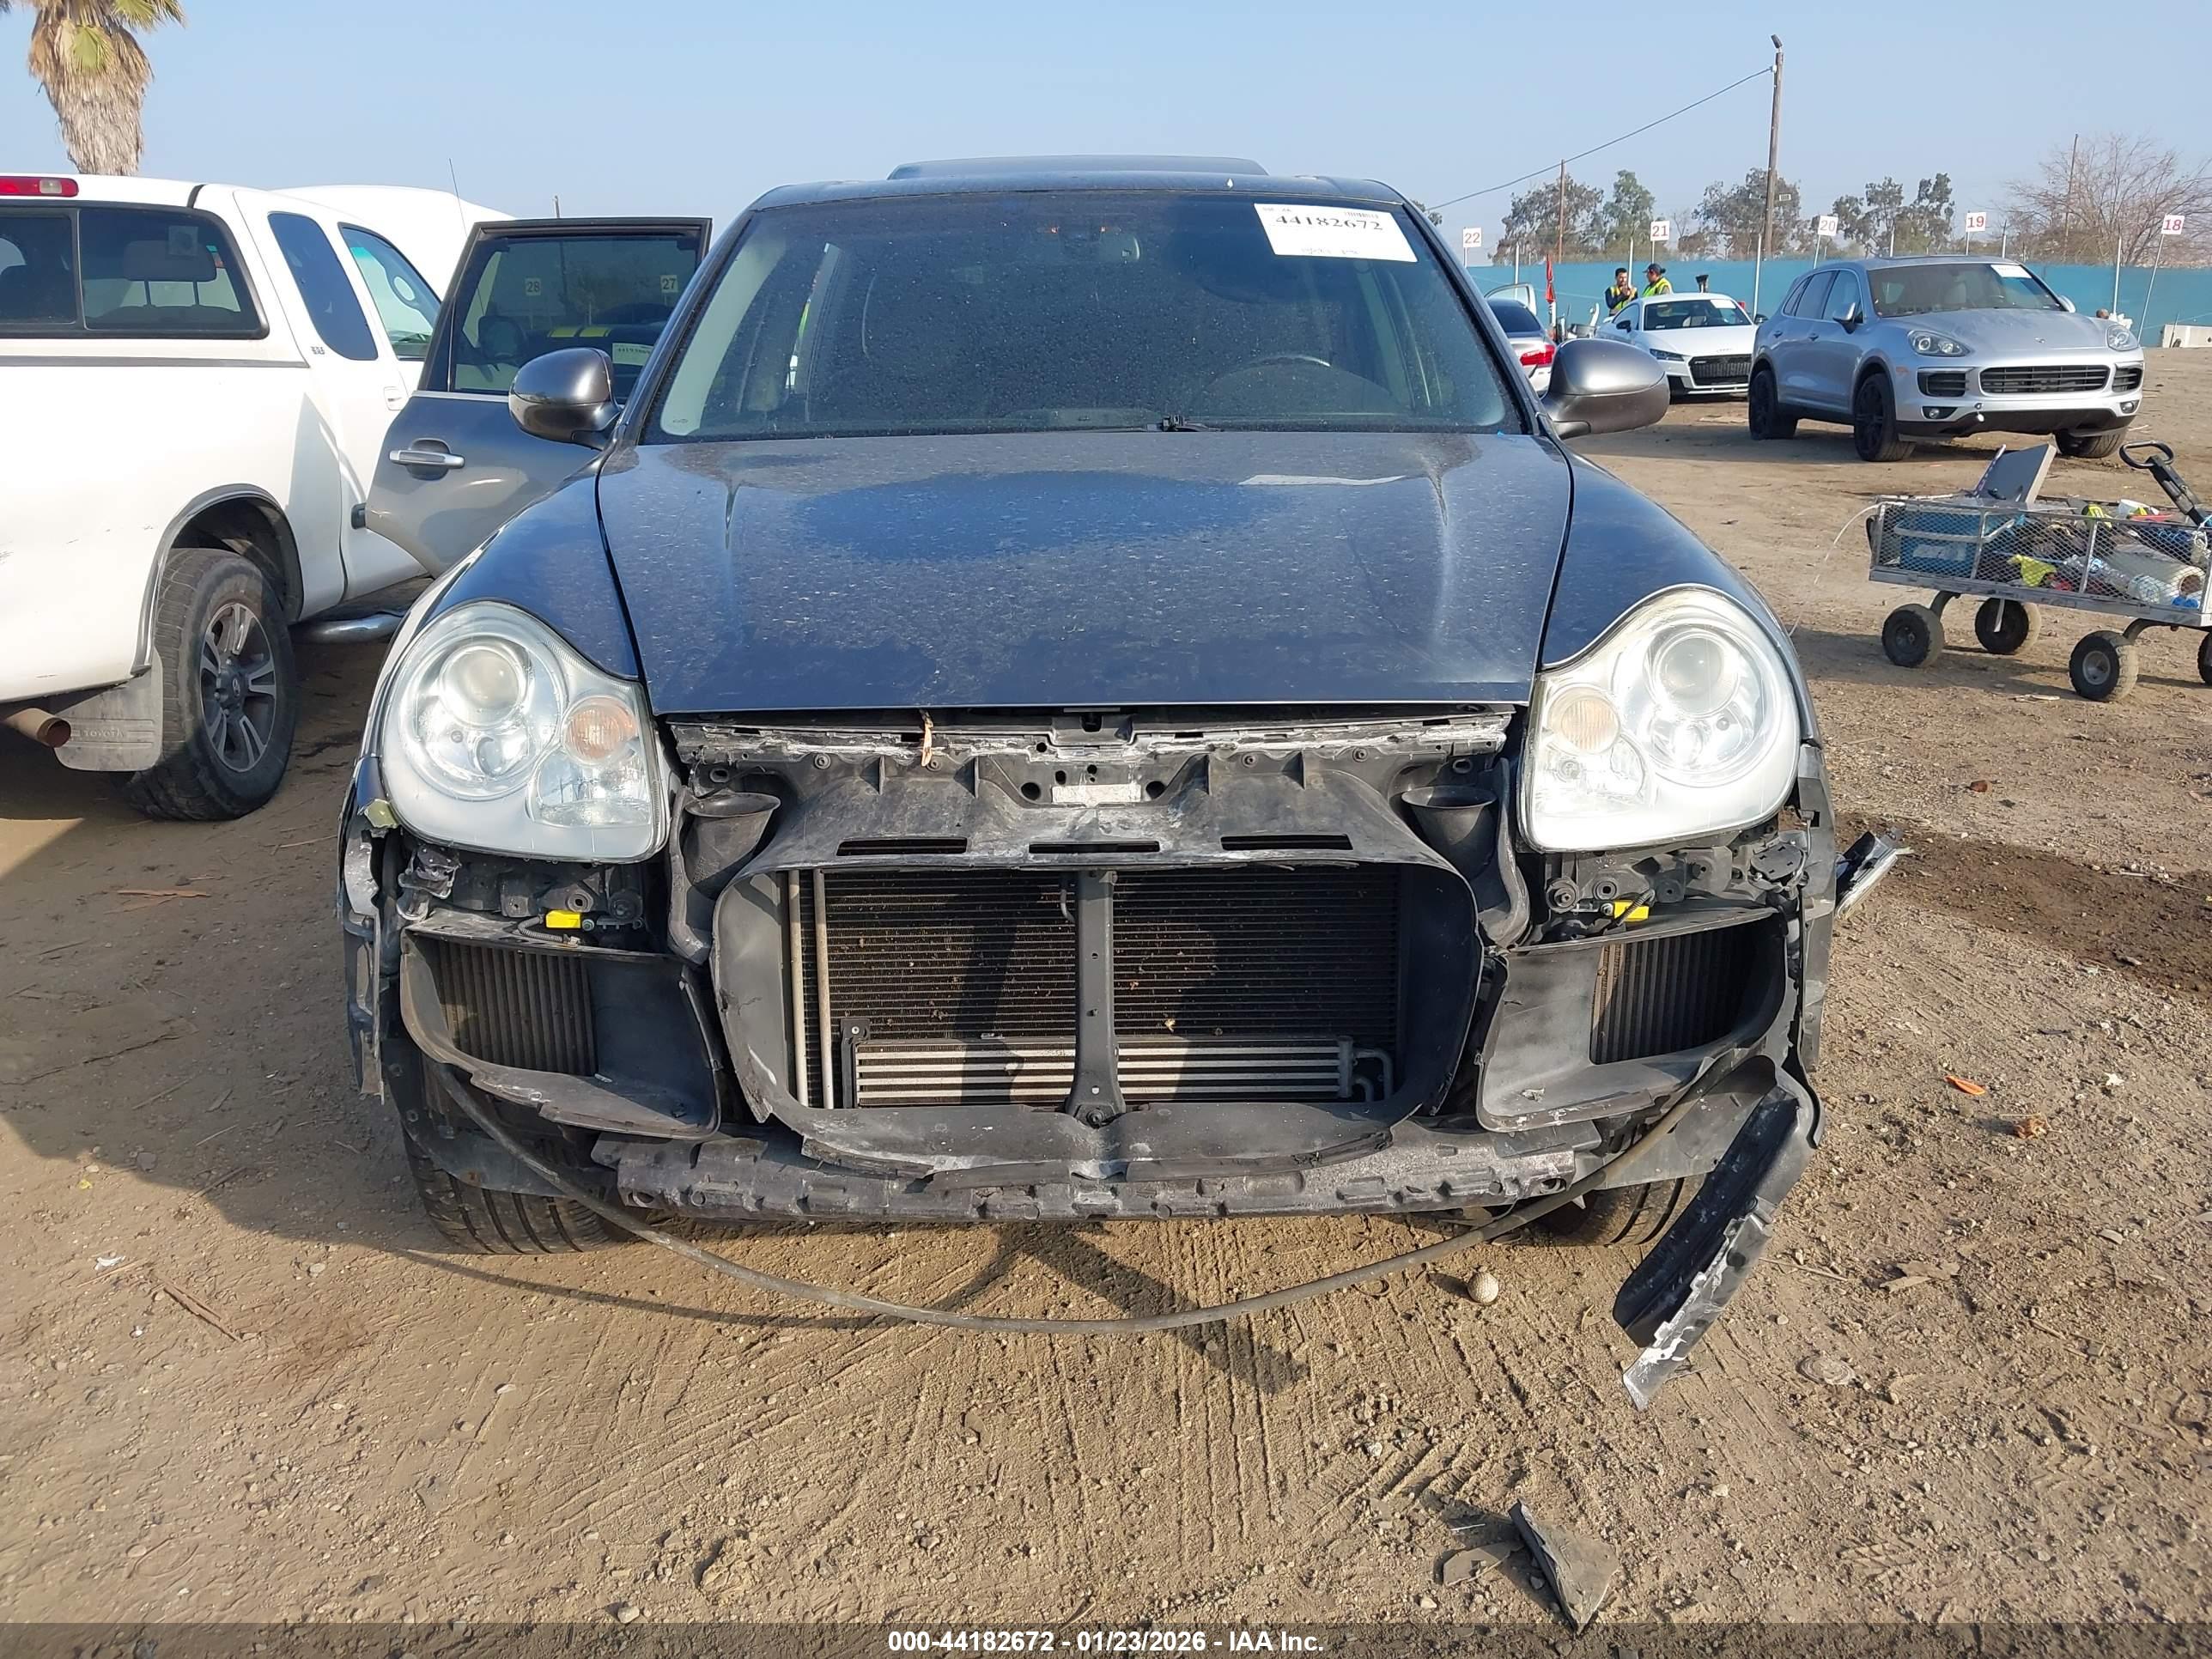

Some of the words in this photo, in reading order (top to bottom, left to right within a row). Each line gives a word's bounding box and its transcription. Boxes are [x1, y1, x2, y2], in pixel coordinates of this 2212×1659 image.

[1275, 215, 1383, 230] 44182672
[1820, 221, 1836, 231] 20
[1966, 216, 1984, 228] 19
[2163, 220, 2182, 231] 18
[1652, 225, 1668, 236] 21
[1465, 232, 1480, 243] 22
[526, 281, 540, 292] 28
[662, 278, 676, 289] 27
[82, 728, 125, 738] TOYOTA
